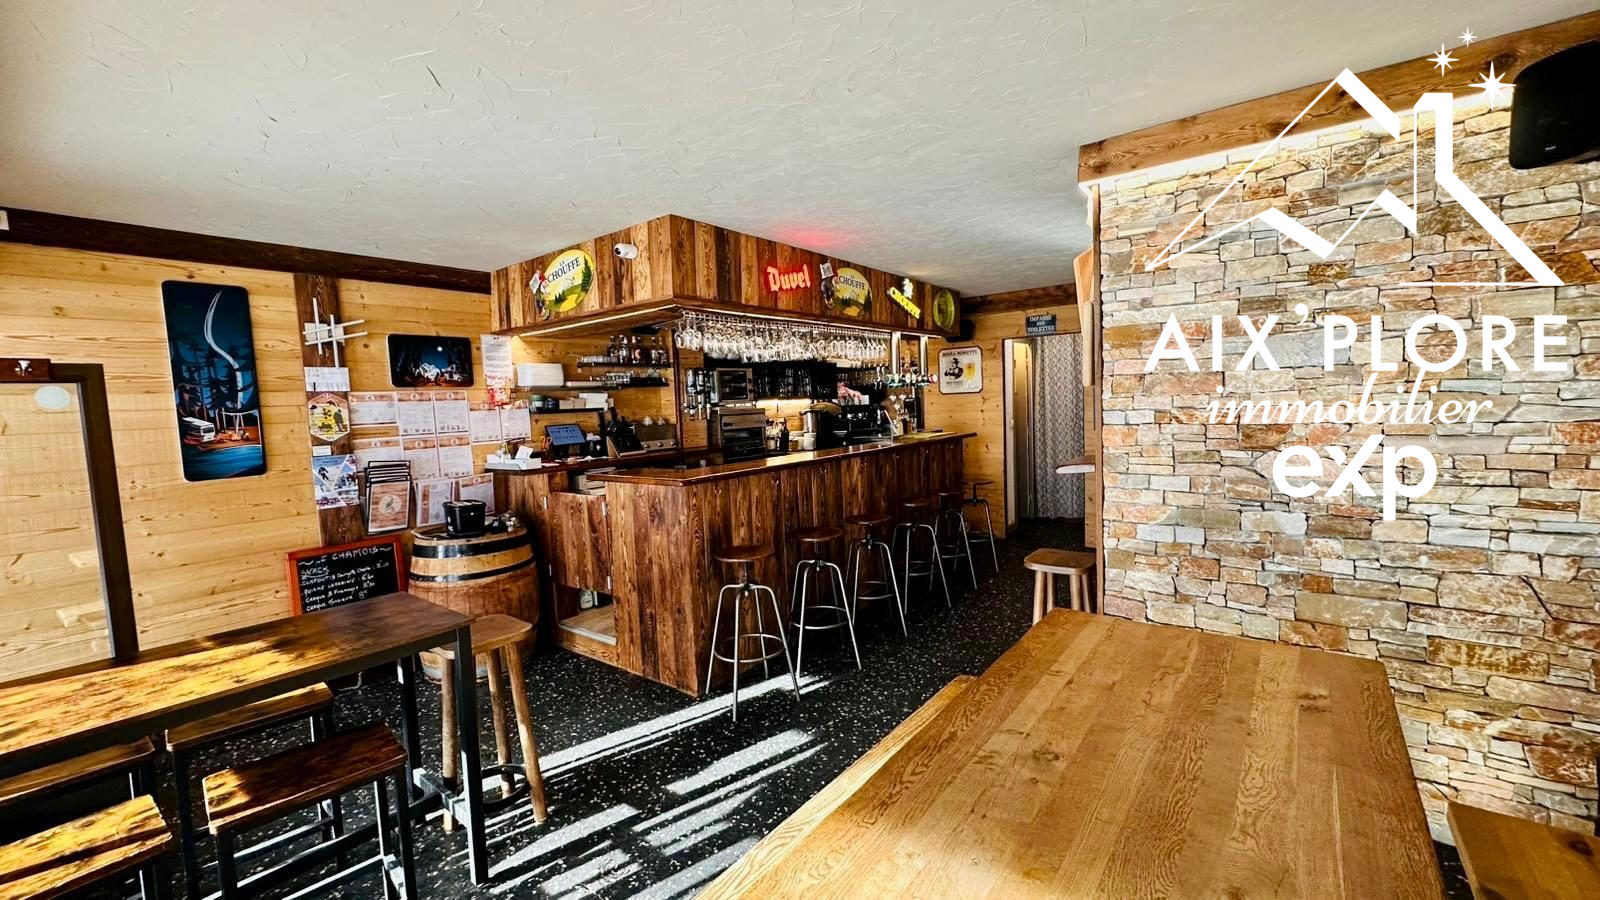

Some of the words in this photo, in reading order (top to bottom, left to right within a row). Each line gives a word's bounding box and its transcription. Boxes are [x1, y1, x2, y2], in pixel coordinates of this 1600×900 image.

[547, 257, 581, 283] CHOUFFE
[766, 263, 811, 292] Duvel
[839, 275, 866, 291] CHOUFFE
[332, 546, 379, 560] CHAMOIS
